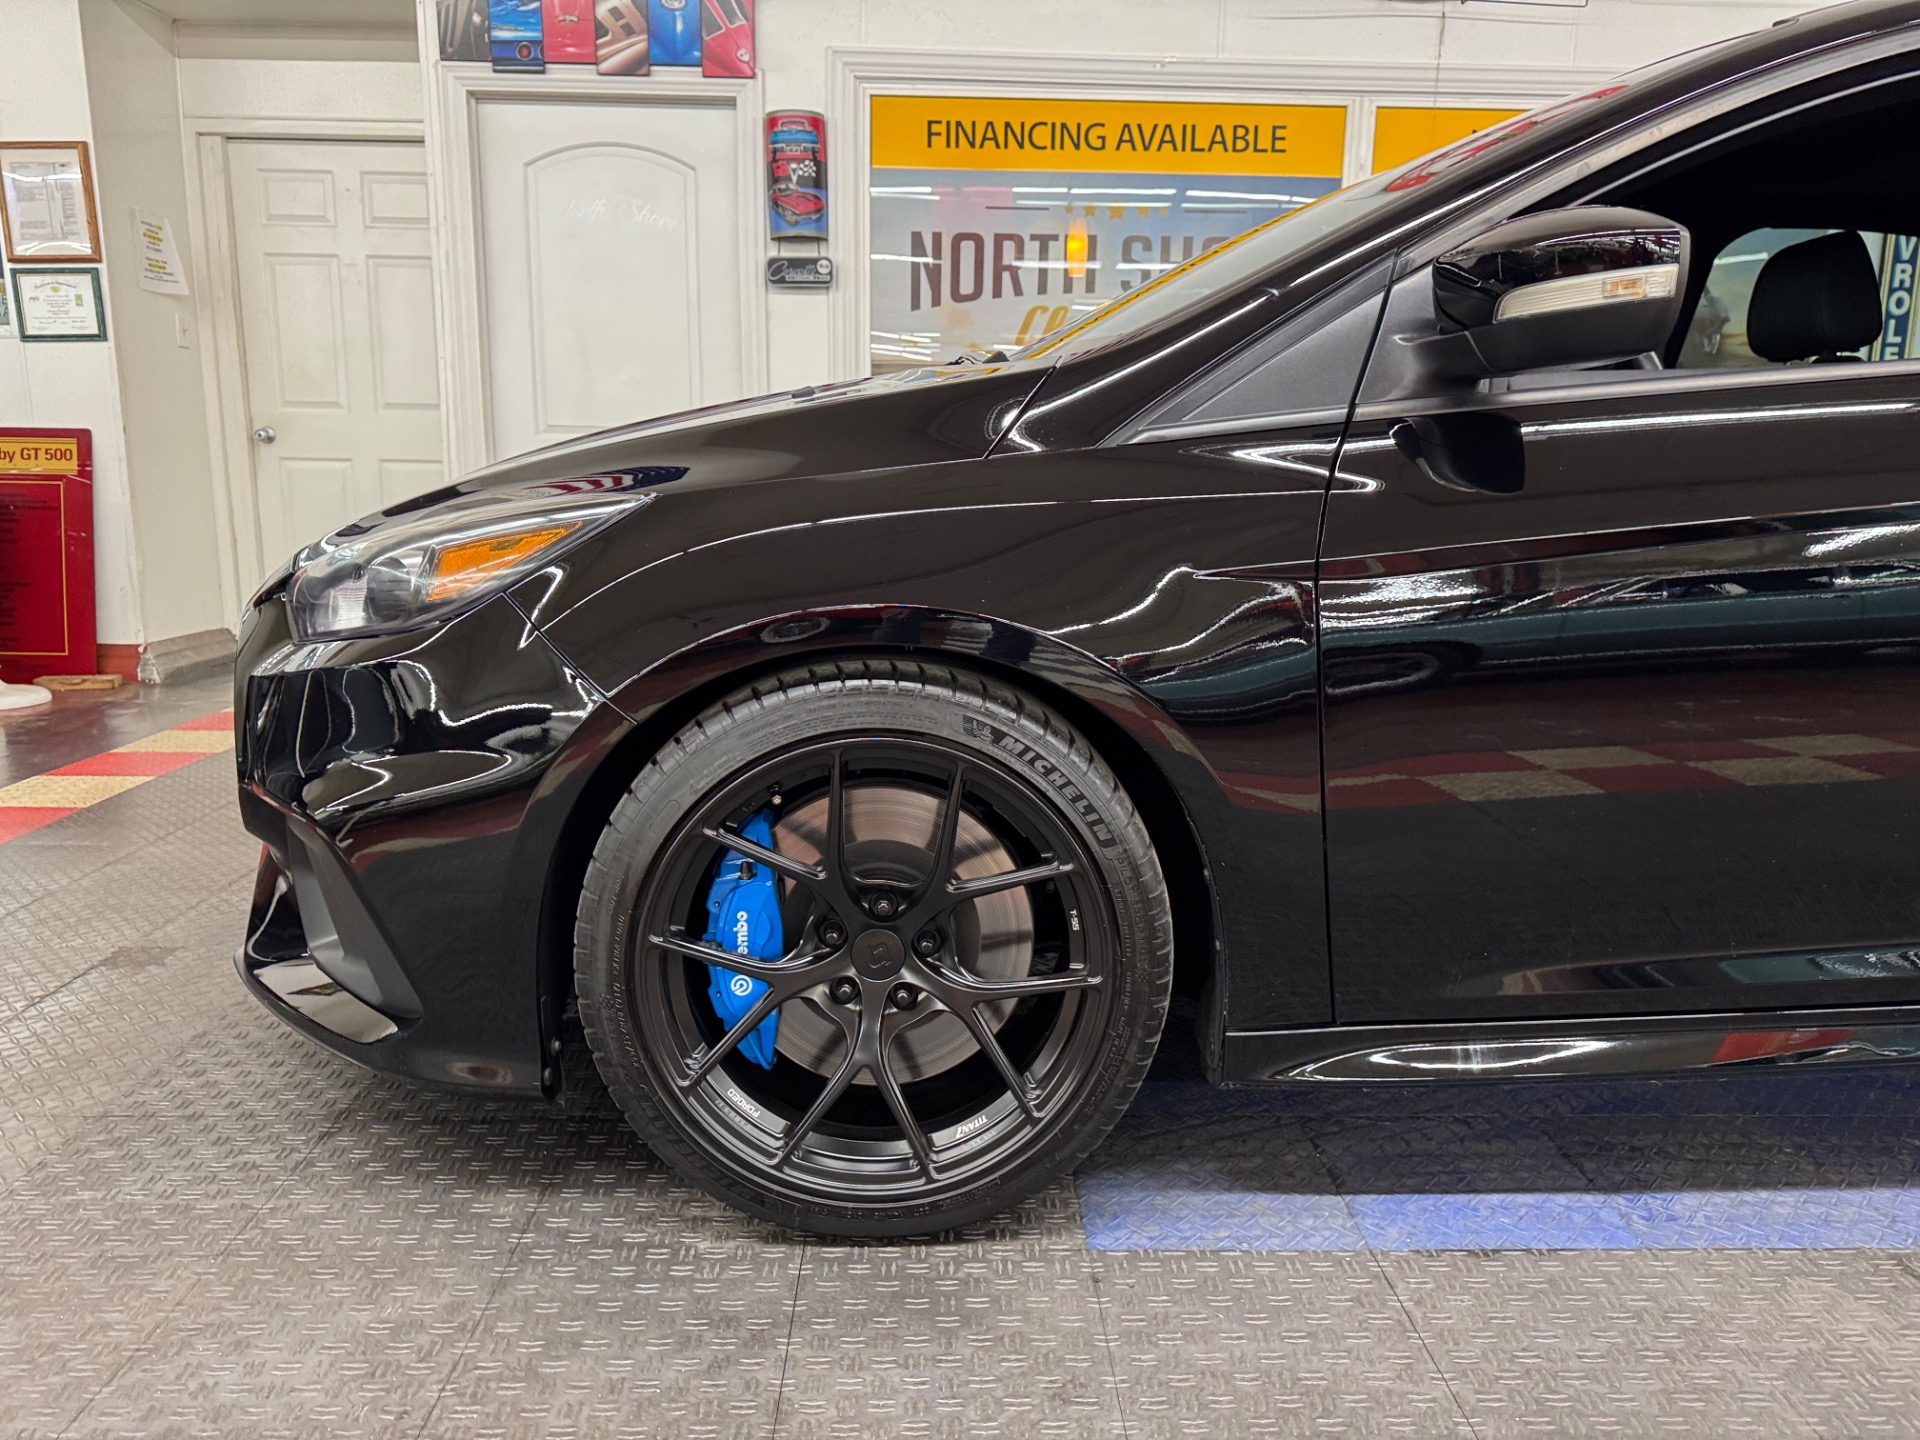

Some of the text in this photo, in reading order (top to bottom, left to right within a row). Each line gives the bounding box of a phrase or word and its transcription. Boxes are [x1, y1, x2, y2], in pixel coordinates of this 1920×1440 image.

[926, 119, 1288, 153] FINANCING AVAILABLE
[910, 230, 1232, 312] NORTH SH
[20, 447, 42, 461] GT
[45, 448, 73, 461] 500
[998, 735, 1113, 841] MICHELIN
[1115, 857, 1136, 894] PILOT
[1131, 900, 1145, 942] SPORT
[732, 910, 749, 955] embo
[726, 1087, 761, 1118] FORGED
[955, 1114, 989, 1139] TITAN7
